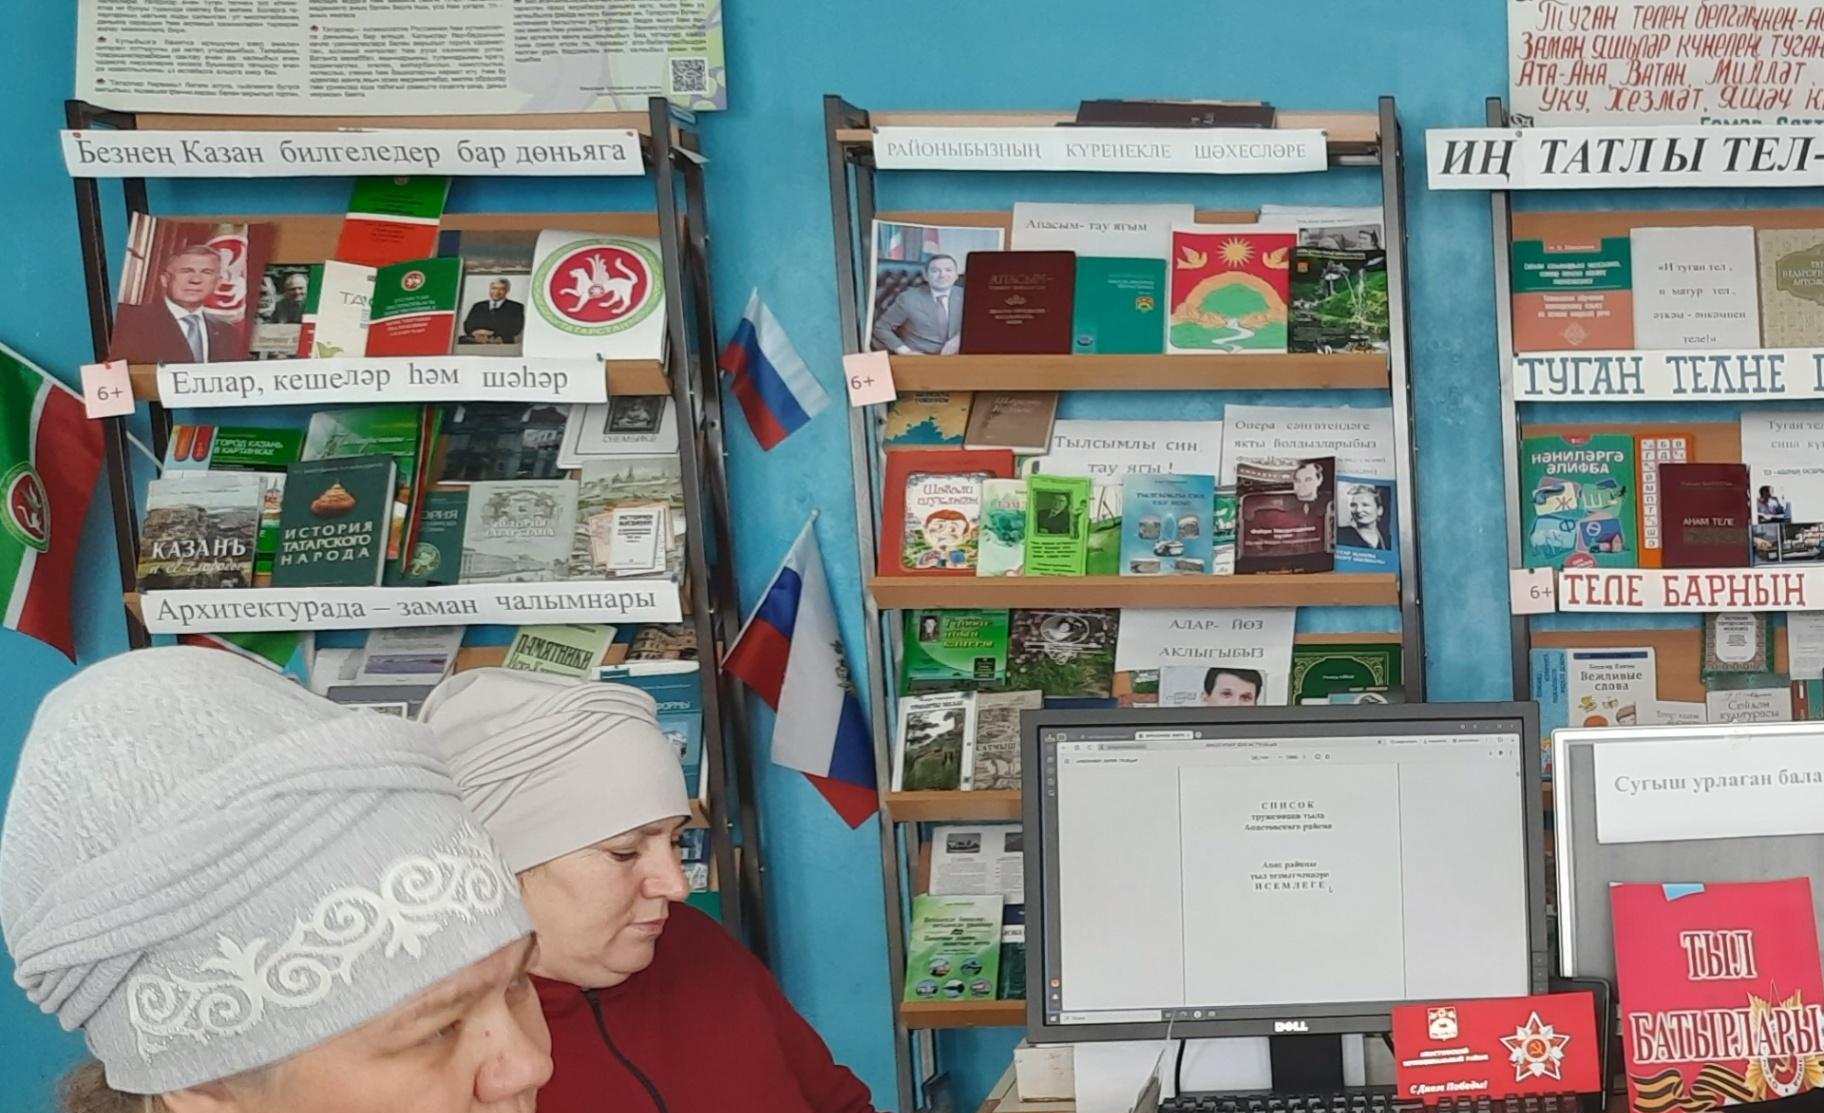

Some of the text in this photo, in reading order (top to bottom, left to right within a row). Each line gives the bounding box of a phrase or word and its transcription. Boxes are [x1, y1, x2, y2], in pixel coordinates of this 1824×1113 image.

[78, 139, 626, 170] Безнең Казан билгеледер бар дөньяга
[888, 140, 1306, 159] РАЙОНЫБЫЗНЫҢ КҮРЕНЕКЛЕ ШӘХЕСЛӘРЕ
[1438, 140, 1513, 183] ИҢ
[1540, 138, 1707, 175] ТАТЛЫ
[173, 361, 568, 399] Еллар, кешеләр һәм шәһәр
[851, 374, 875, 391] 6+
[1517, 357, 1645, 394] ТУГАН
[1666, 354, 1785, 394] ТЕЛНЕ
[96, 384, 124, 402] 6+
[1054, 435, 1198, 451] Тылсымлы син
[1532, 450, 1625, 464] НӘНИЛӘРГӘ
[1088, 462, 1119, 477] тау
[1546, 461, 1610, 475] ӘЛИФБА
[284, 521, 373, 540] ИСТОРИЯ
[1713, 518, 1735, 526] ТЕЛЕ
[152, 539, 247, 560] КАЗАНЬ
[282, 533, 372, 552] ТАТАРСКОГО
[281, 548, 370, 566] НАРОДА
[1530, 586, 1552, 599] 6+
[1563, 574, 1643, 607] ТЕЛЕ
[1663, 573, 1806, 607] БАРНЫҢ
[156, 590, 656, 628] Архитектурада заман чалымнары
[517, 634, 595, 670] ПАМЯТНИКИ
[1581, 671, 1643, 681] Вежливые
[1595, 683, 1629, 691] слова
[1614, 775, 1686, 795] Сугыш
[1692, 772, 1773, 794] урлаган
[1681, 931, 1757, 980] ТЫЛ
[1275, 1021, 1308, 1032] DELL
